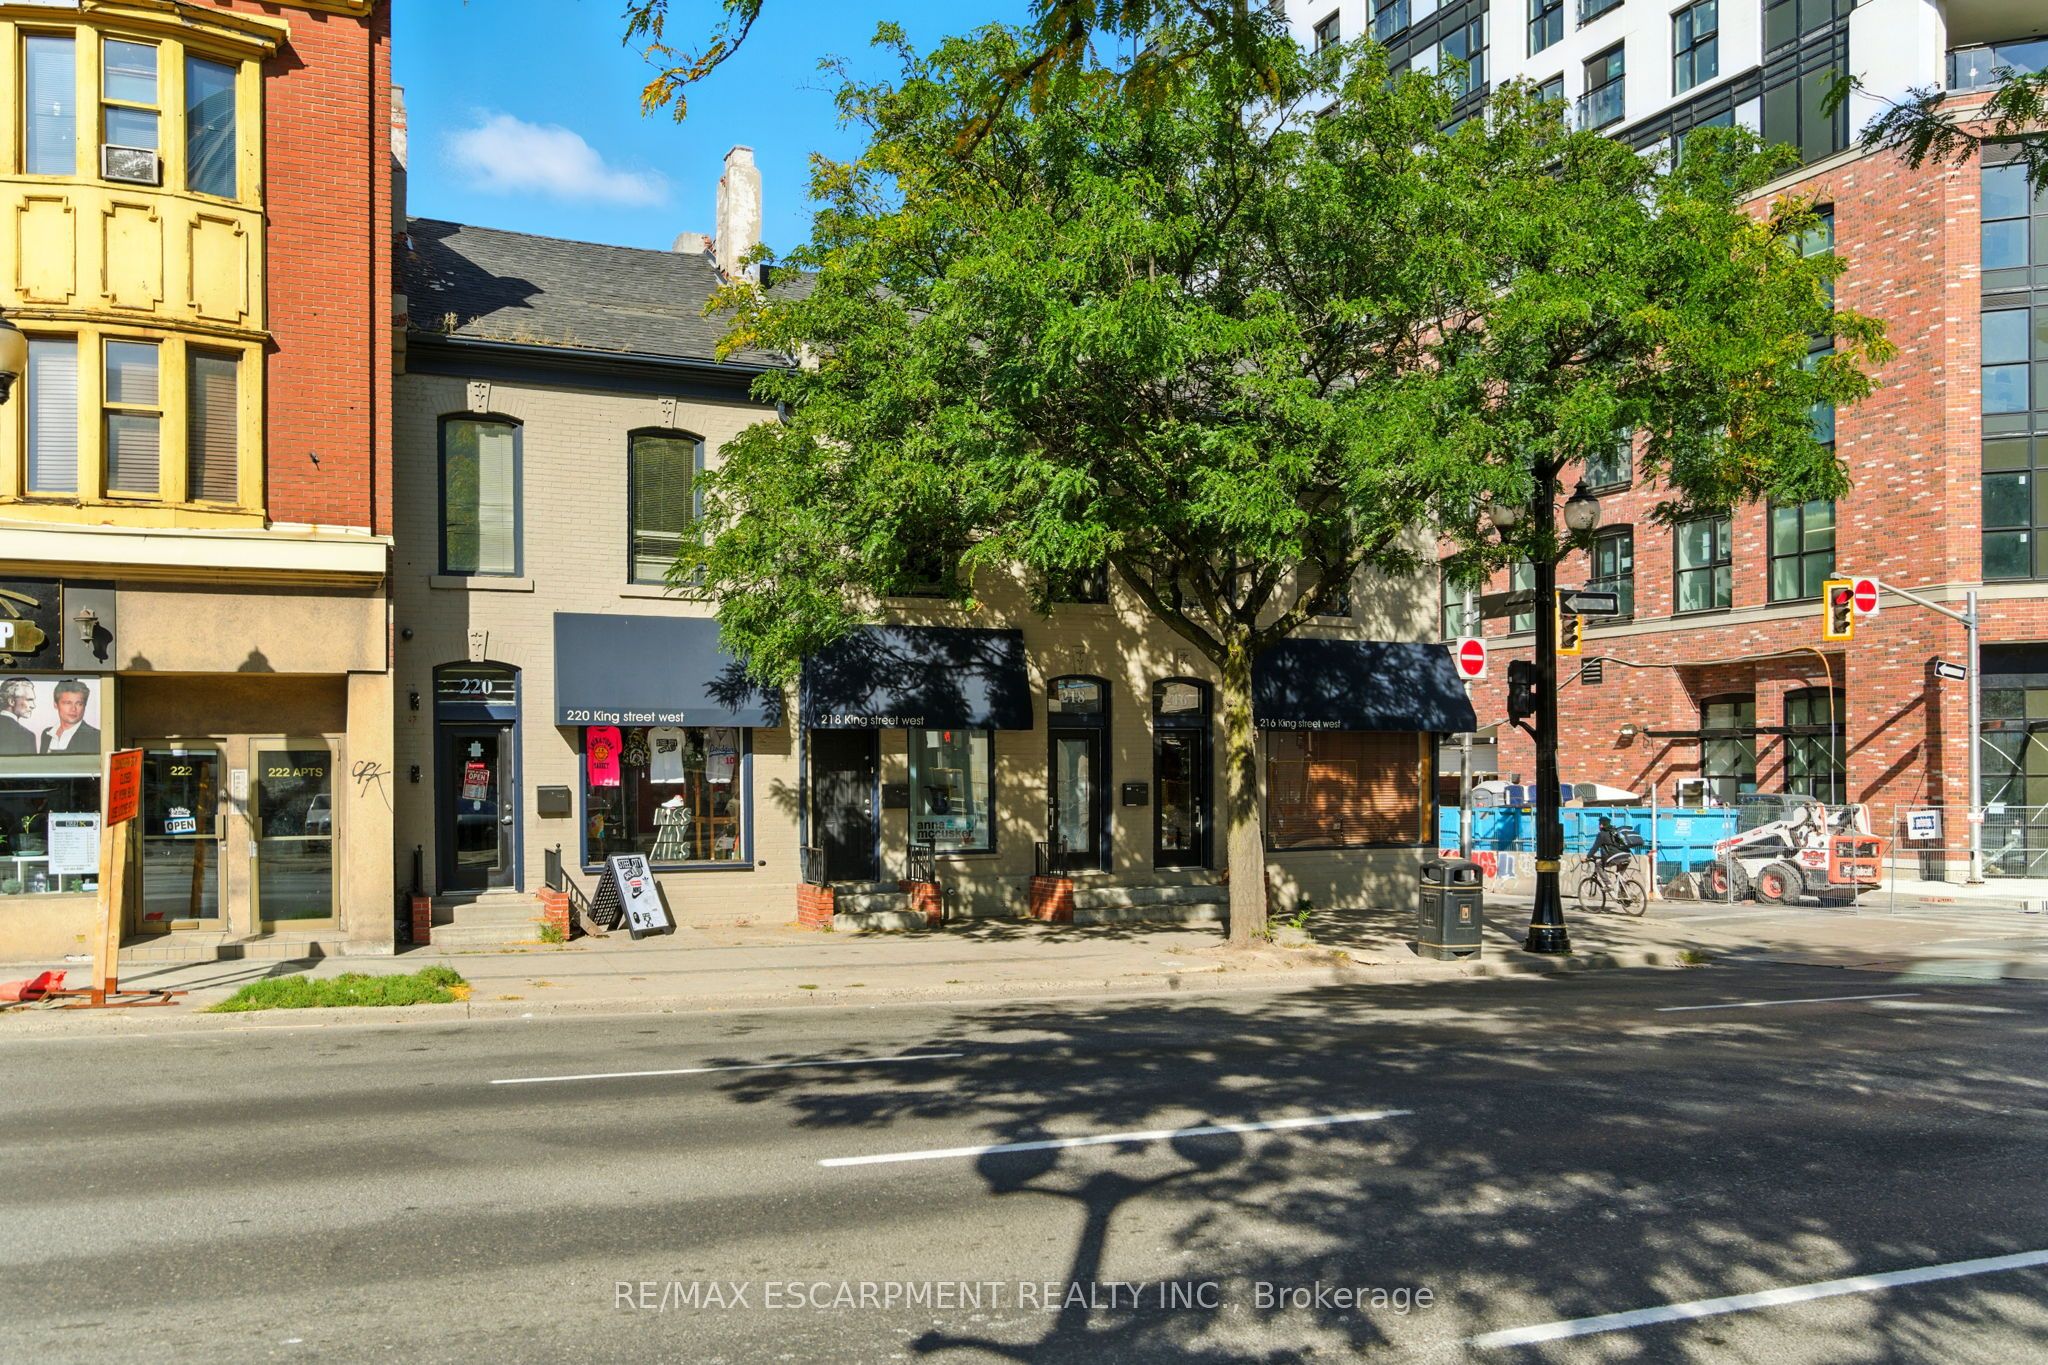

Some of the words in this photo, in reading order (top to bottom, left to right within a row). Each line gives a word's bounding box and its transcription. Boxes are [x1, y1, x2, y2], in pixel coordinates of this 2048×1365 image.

[459, 678, 493, 695] 220
[1061, 689, 1086, 704] 218
[567, 710, 590, 721] 220
[593, 710, 620, 724] King
[623, 711, 656, 722] street
[658, 712, 685, 723] west
[821, 714, 842, 725] 218
[844, 714, 868, 727] King
[870, 715, 899, 726] street
[901, 715, 925, 726] west
[1260, 718, 1277, 728] 216
[1278, 718, 1297, 730] King
[1298, 719, 1321, 729] street
[1322, 719, 1342, 729] west
[170, 765, 193, 776] 222
[268, 767, 290, 778] 222
[292, 767, 324, 778] APTS
[468, 772, 486, 781] OPEN
[653, 807, 692, 826] KISS
[166, 819, 195, 832] OPEN
[916, 821, 946, 830] anna
[656, 825, 689, 843] MY
[916, 828, 974, 839] mccusker
